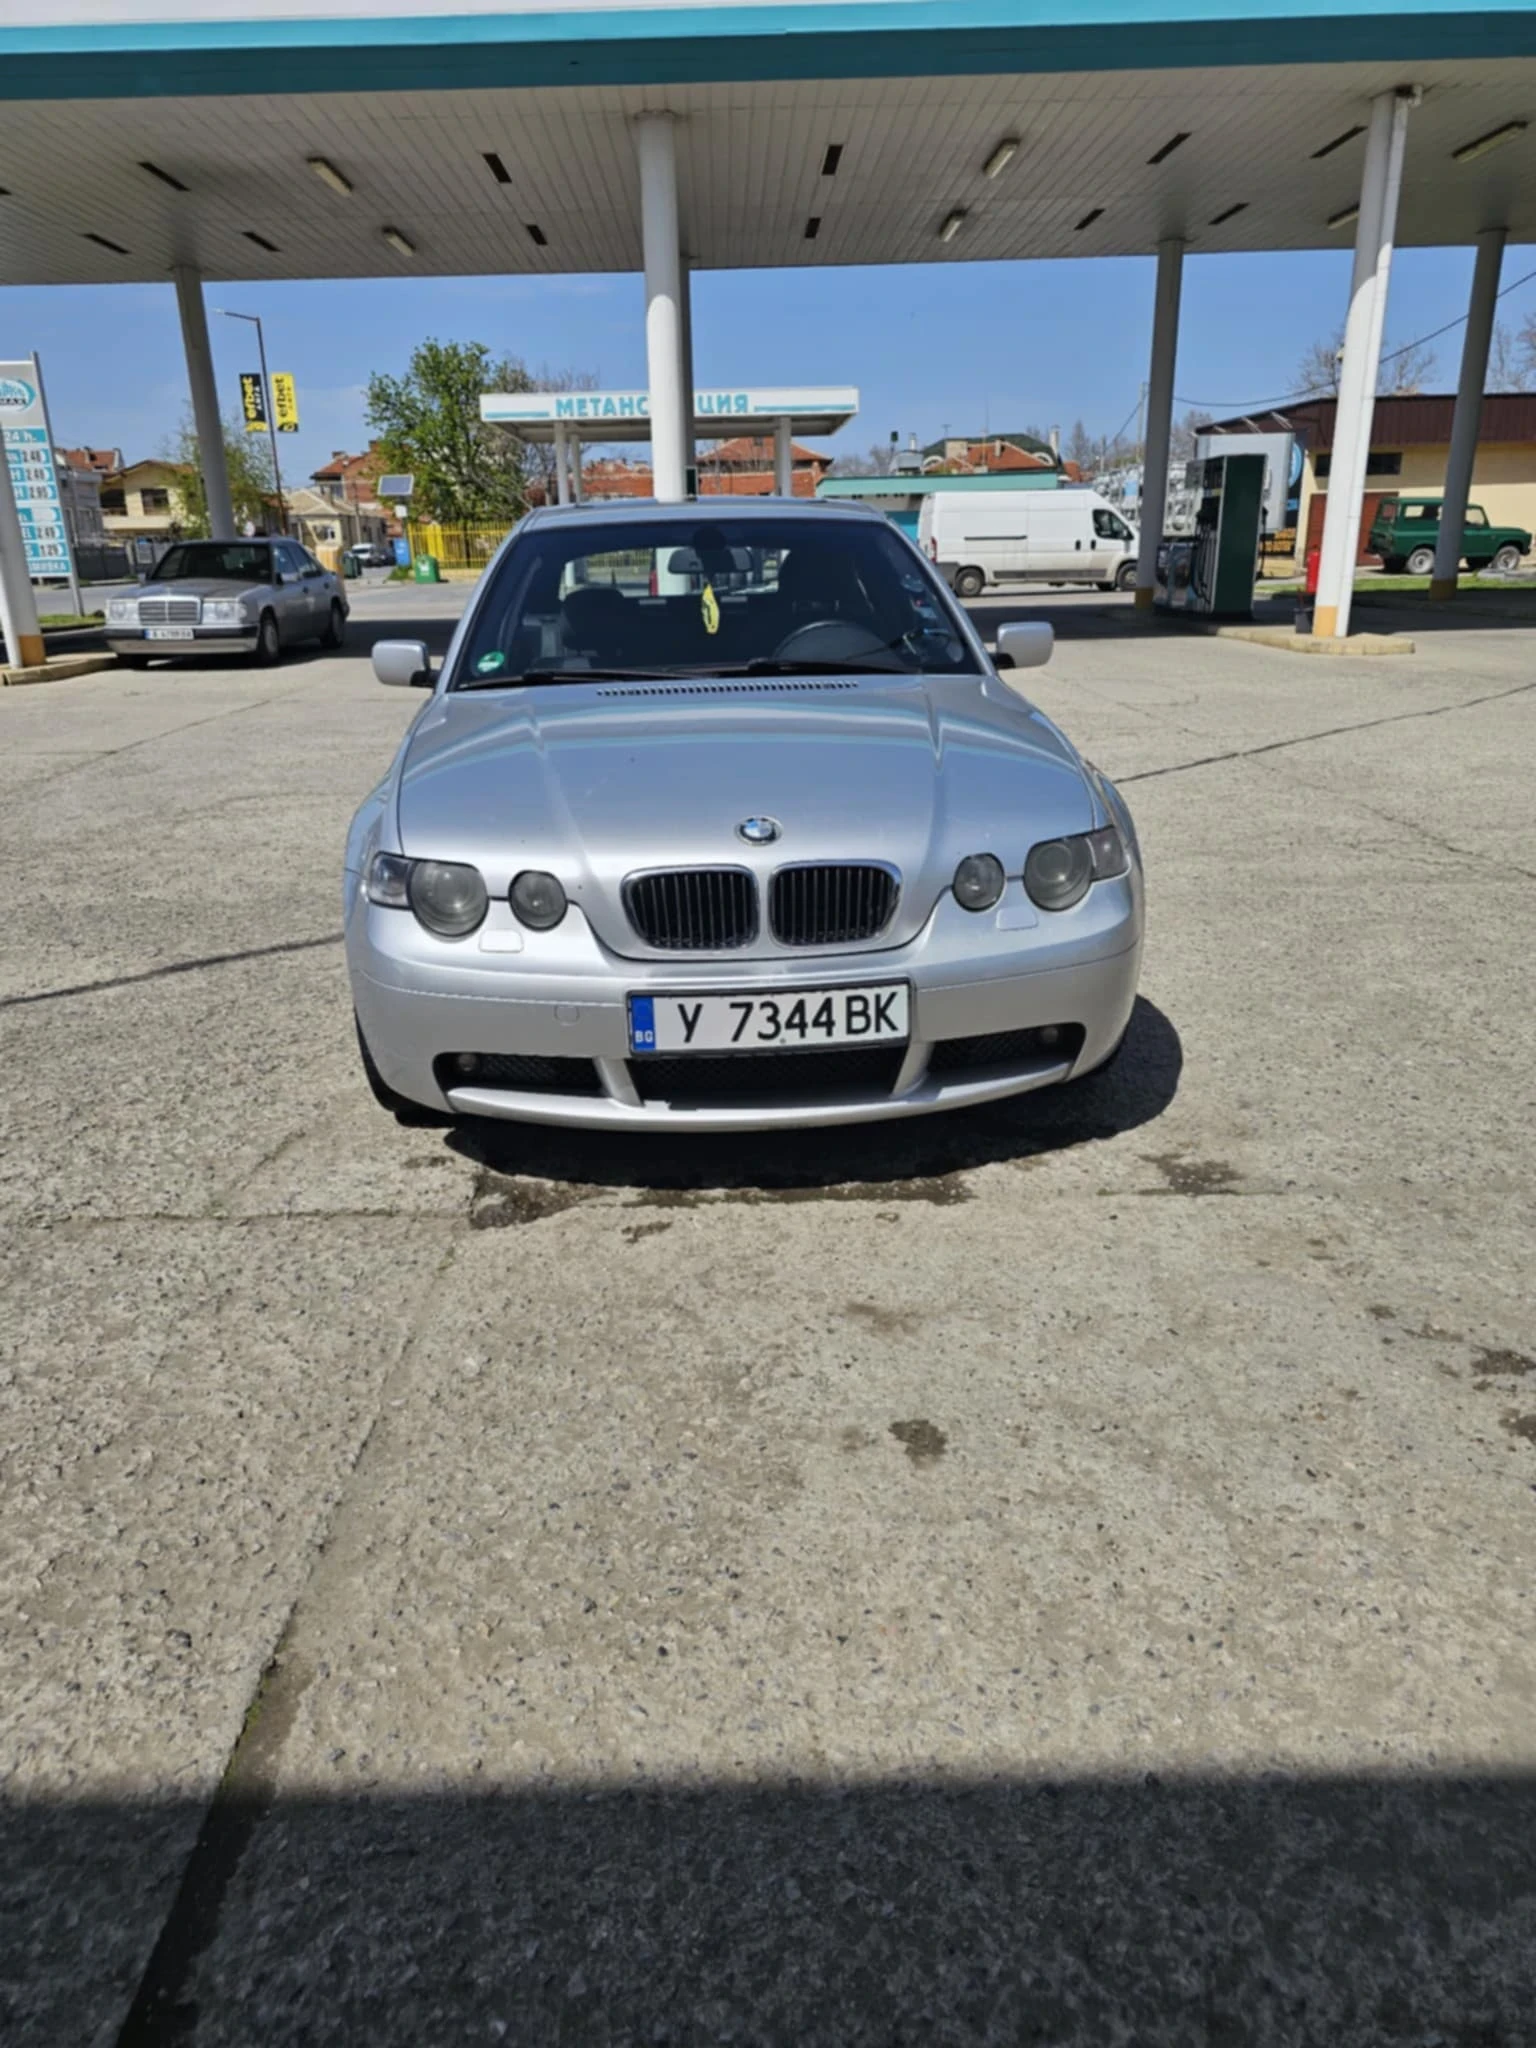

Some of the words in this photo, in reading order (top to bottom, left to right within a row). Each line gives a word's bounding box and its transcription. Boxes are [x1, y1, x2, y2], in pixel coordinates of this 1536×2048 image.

[275, 377, 288, 418] efbet
[556, 394, 748, 417] МЕТАНСЦИЯ
[634, 1030, 654, 1043] BG
